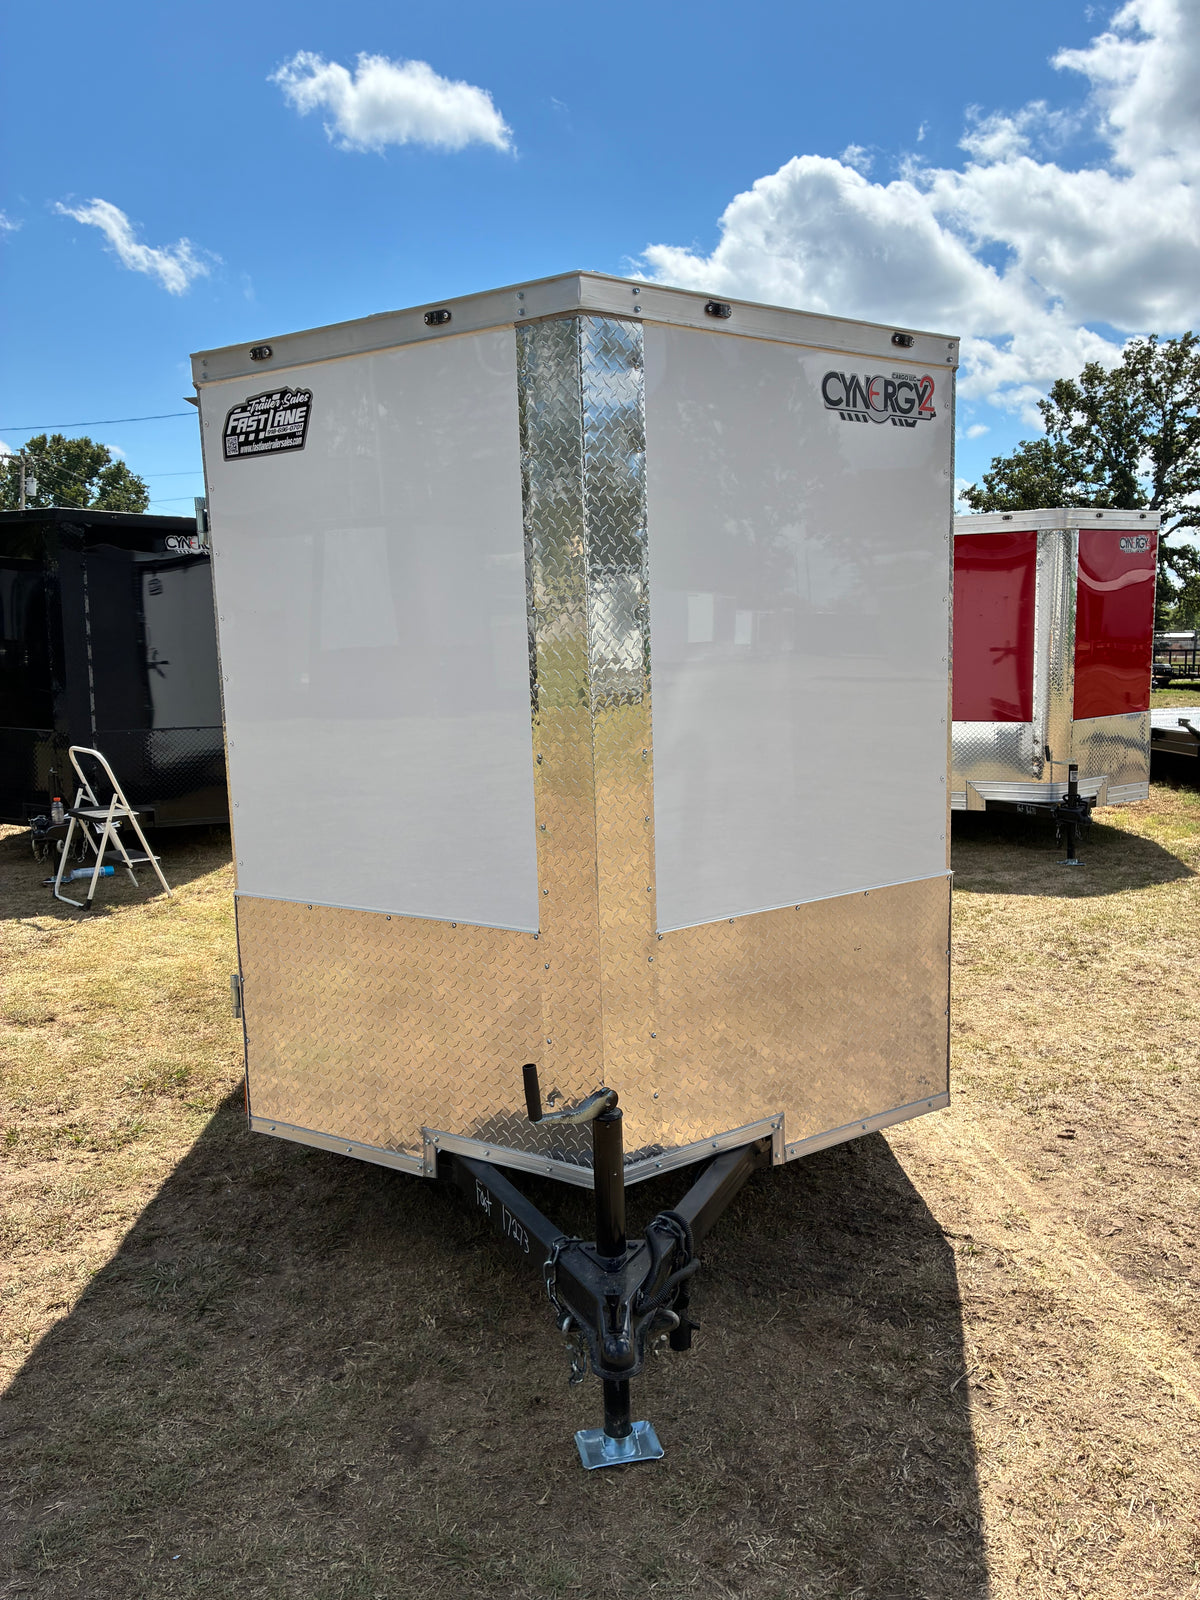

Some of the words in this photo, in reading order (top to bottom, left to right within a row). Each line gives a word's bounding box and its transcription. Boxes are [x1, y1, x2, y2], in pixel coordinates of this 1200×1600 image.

[892, 373, 908, 381] CARGO
[248, 398, 281, 414] Trailer
[281, 392, 310, 408] Sales
[226, 411, 268, 435] FAST
[265, 406, 307, 437] LANE
